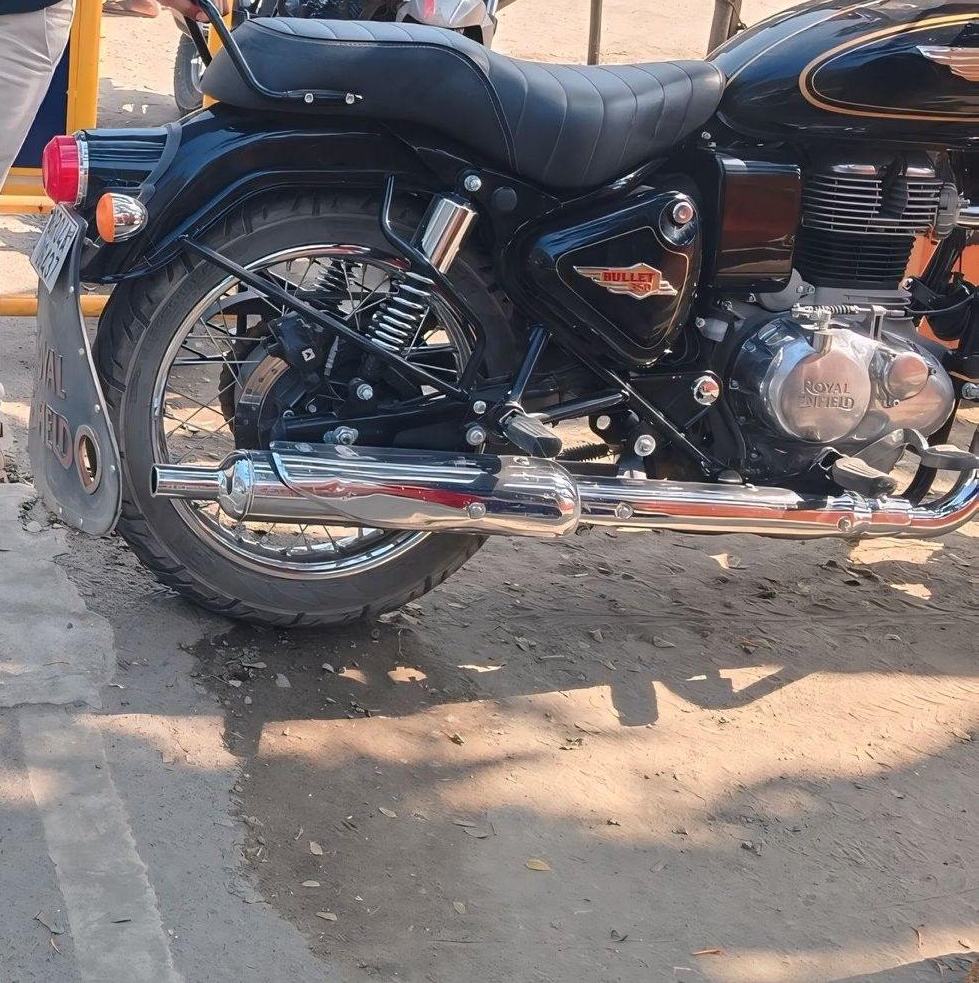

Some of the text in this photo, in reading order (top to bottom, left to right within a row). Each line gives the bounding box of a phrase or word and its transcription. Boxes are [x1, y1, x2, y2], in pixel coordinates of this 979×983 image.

[603, 271, 655, 283] BULLET
[802, 377, 851, 396] ROYAL
[796, 395, 855, 412] ENFIELD
